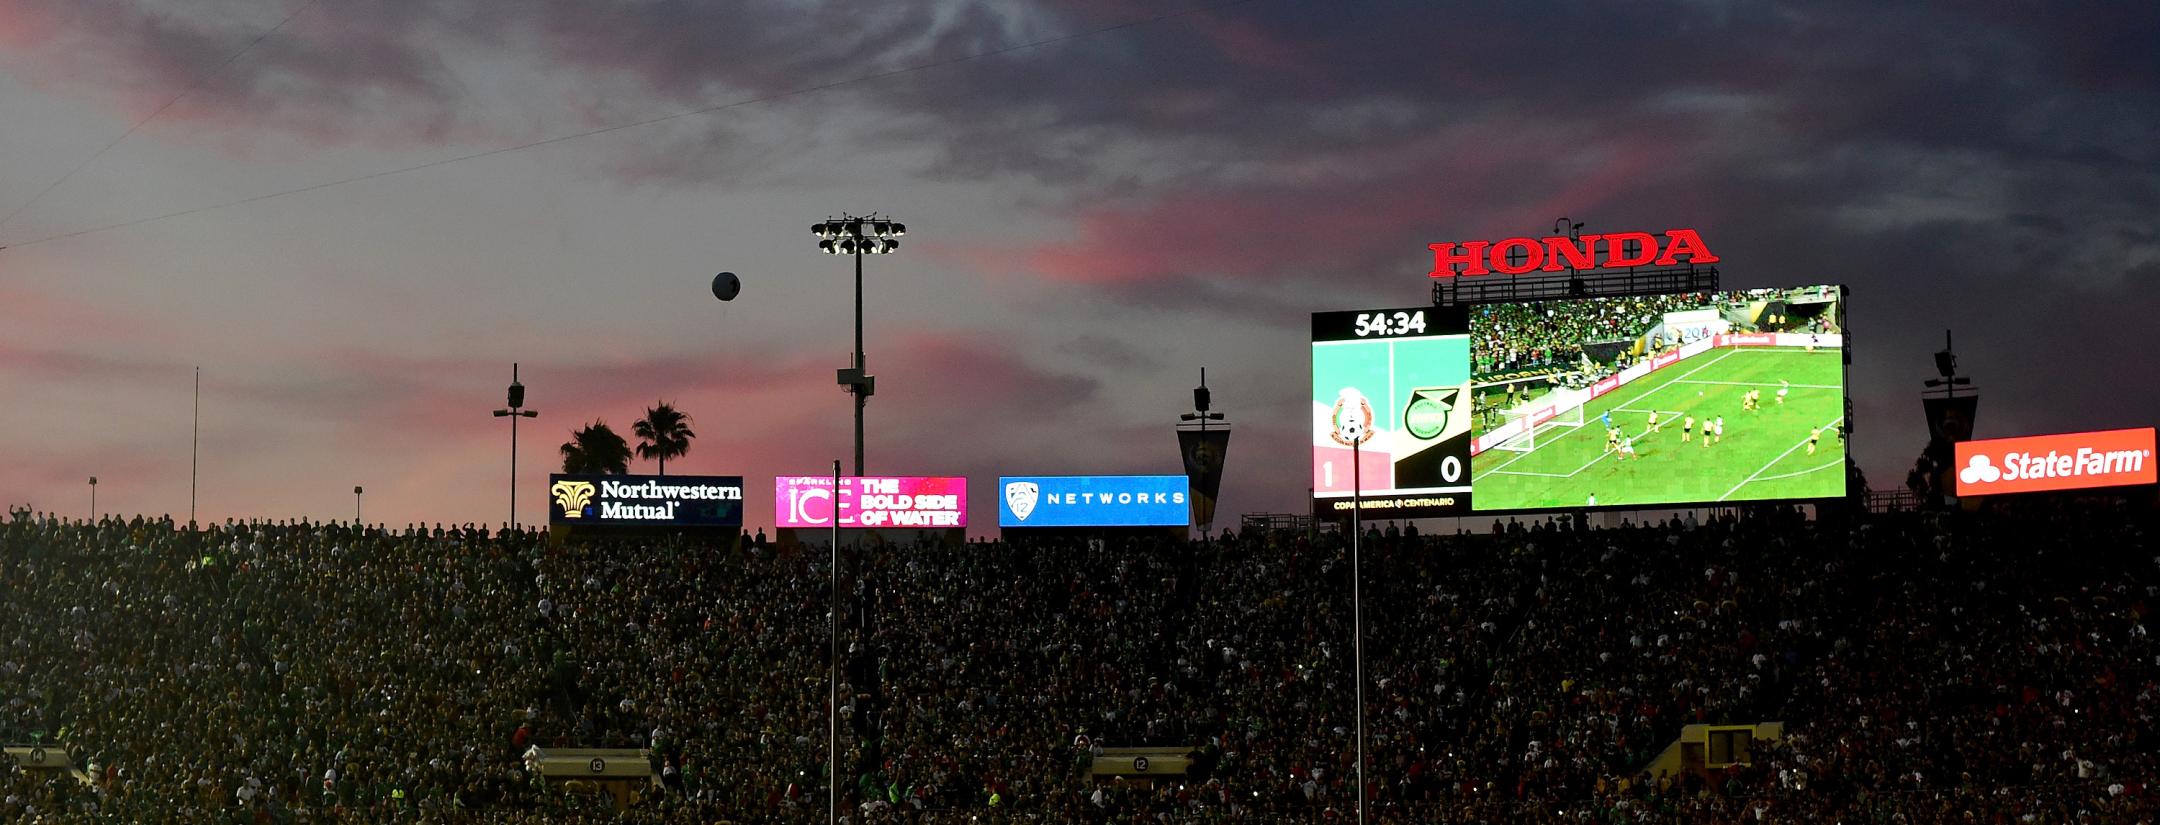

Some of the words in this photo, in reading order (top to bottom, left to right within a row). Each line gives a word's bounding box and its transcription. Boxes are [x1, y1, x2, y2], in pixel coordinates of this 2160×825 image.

[1428, 229, 1719, 278] HONDA
[1354, 311, 1426, 337] 54:34
[1323, 461, 1333, 487] 1
[1440, 455, 1462, 483] 0
[601, 480, 742, 500] Northwestern
[860, 479, 899, 494] THE
[788, 488, 855, 524] ICE
[860, 495, 913, 510] BOLD
[914, 495, 957, 510] SIDE
[1047, 492, 1185, 505] NETWORKS
[1404, 497, 1455, 507] CENTENARIO
[860, 511, 889, 526] OF
[890, 511, 960, 526] WATER
[32, 751, 43, 761] 14
[592, 761, 602, 770] 13
[1136, 760, 1146, 769] 12
